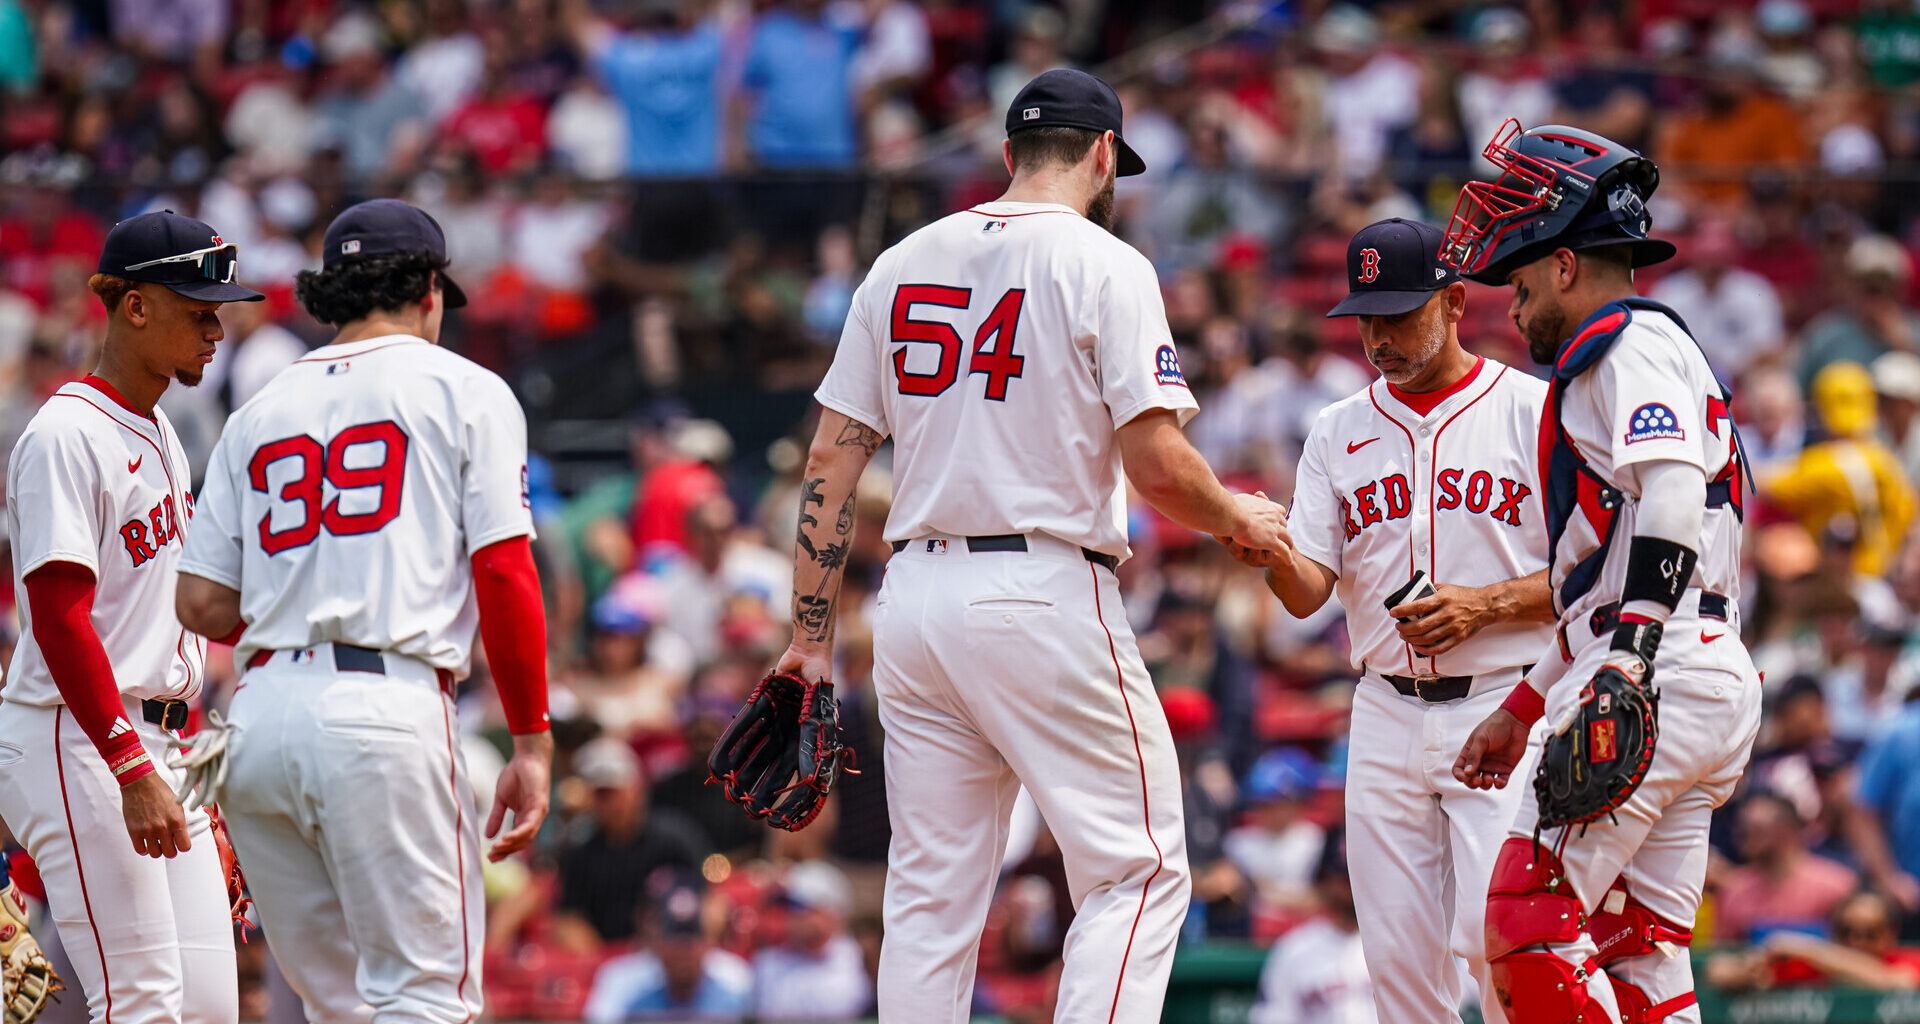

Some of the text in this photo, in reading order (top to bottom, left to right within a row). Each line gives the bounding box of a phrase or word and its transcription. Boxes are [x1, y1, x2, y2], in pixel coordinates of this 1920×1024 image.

[1358, 248, 1381, 284] B
[890, 284, 1026, 402] 54
[1627, 429, 1684, 443] MassMutual
[247, 420, 409, 557] 39
[1437, 468, 1532, 526] SOX
[119, 494, 175, 568] RED
